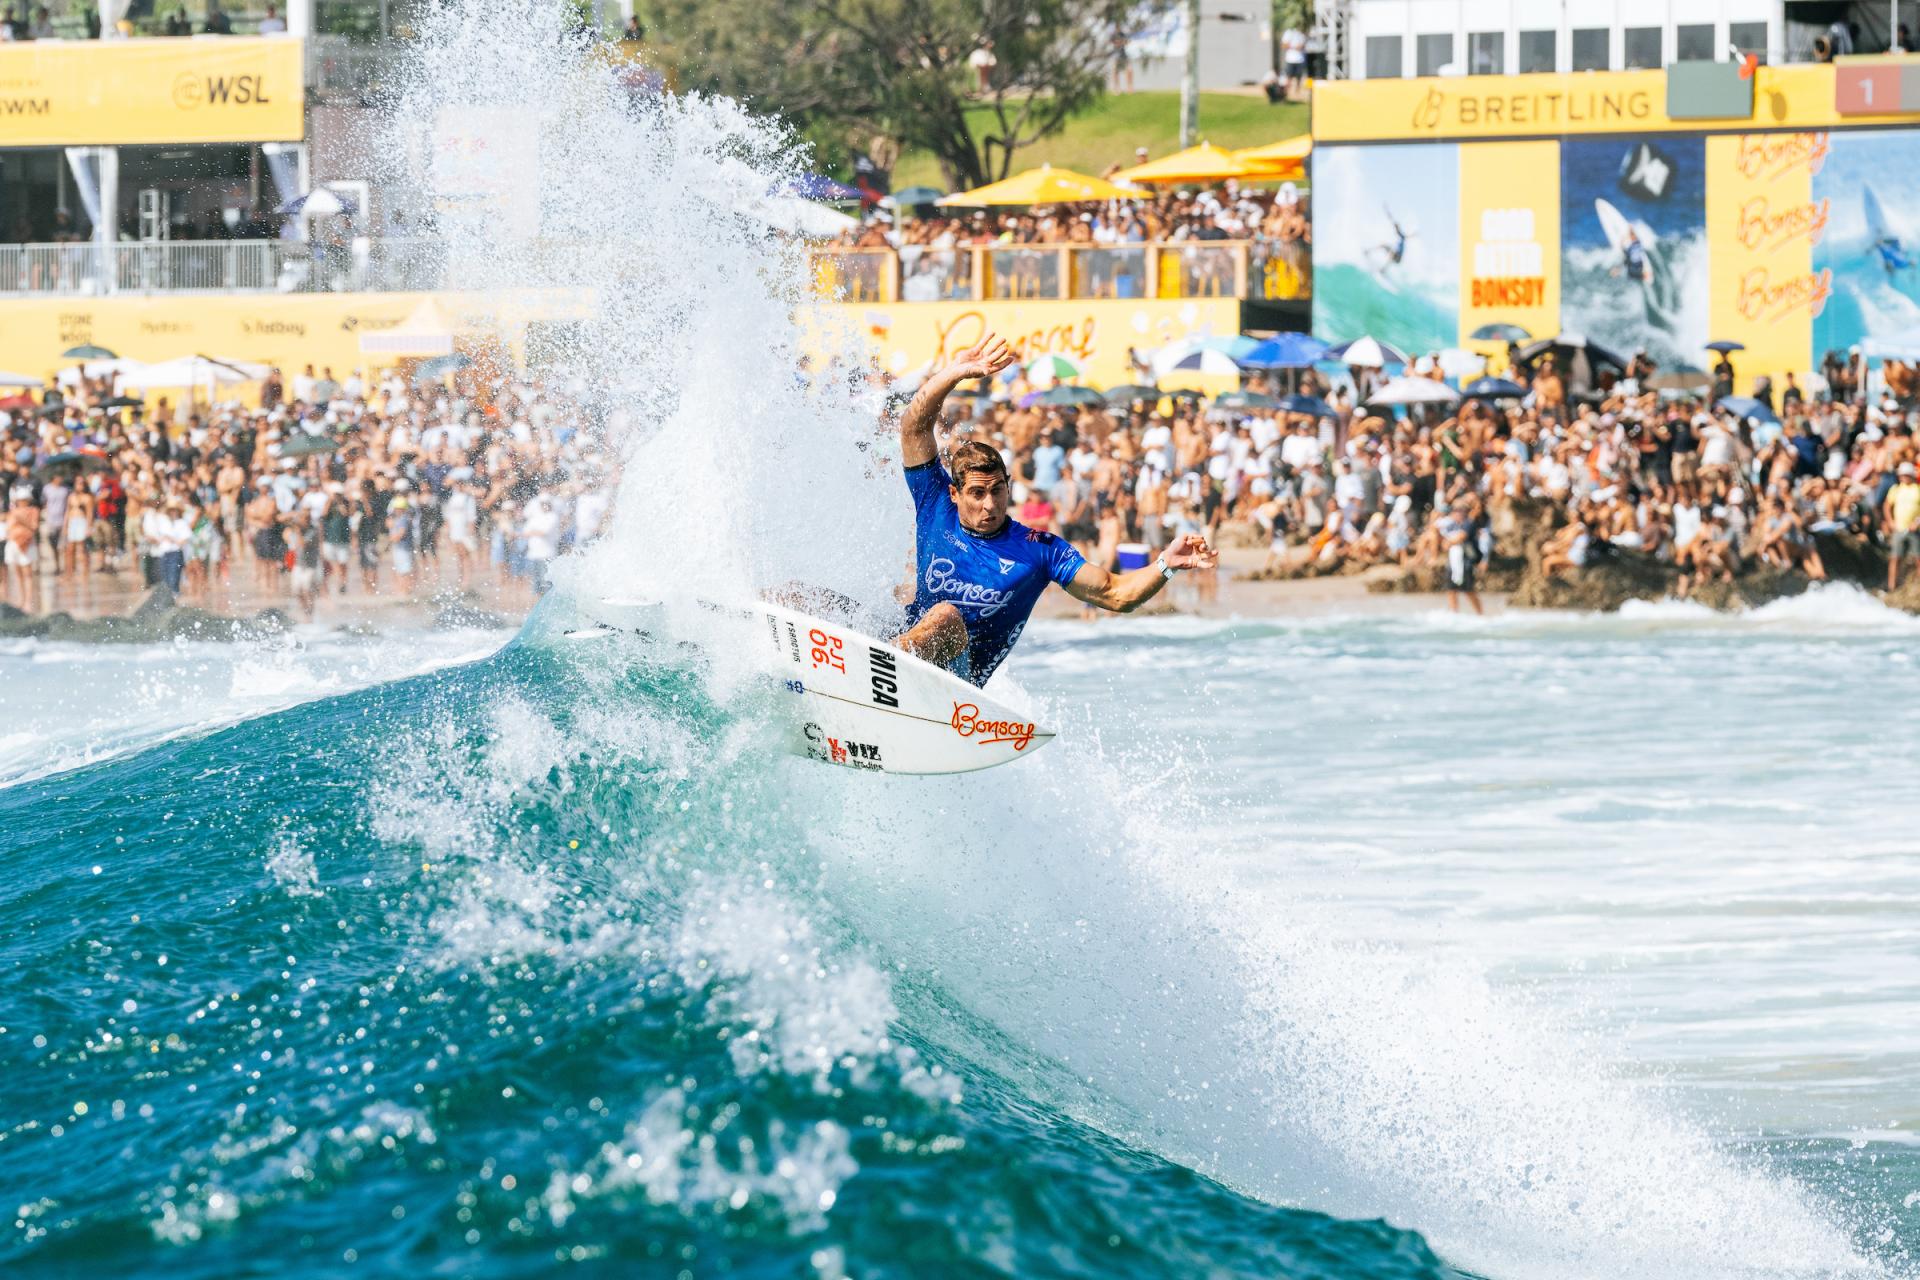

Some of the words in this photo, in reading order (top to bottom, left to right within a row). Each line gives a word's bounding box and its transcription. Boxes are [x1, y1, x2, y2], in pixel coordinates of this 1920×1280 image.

[0, 98, 50, 115] WM
[206, 75, 269, 104] WSL
[1459, 91, 1651, 124] BREITLING
[1857, 78, 1874, 106] 1
[1738, 196, 1830, 251] Bonsoy
[1472, 278, 1546, 308] BONSOY
[1738, 266, 1832, 323] Bonsoy
[925, 552, 1014, 617] Bonsoy
[828, 635, 846, 675] PJT
[869, 646, 899, 708] MICA
[951, 701, 1035, 751] Bonsoy
